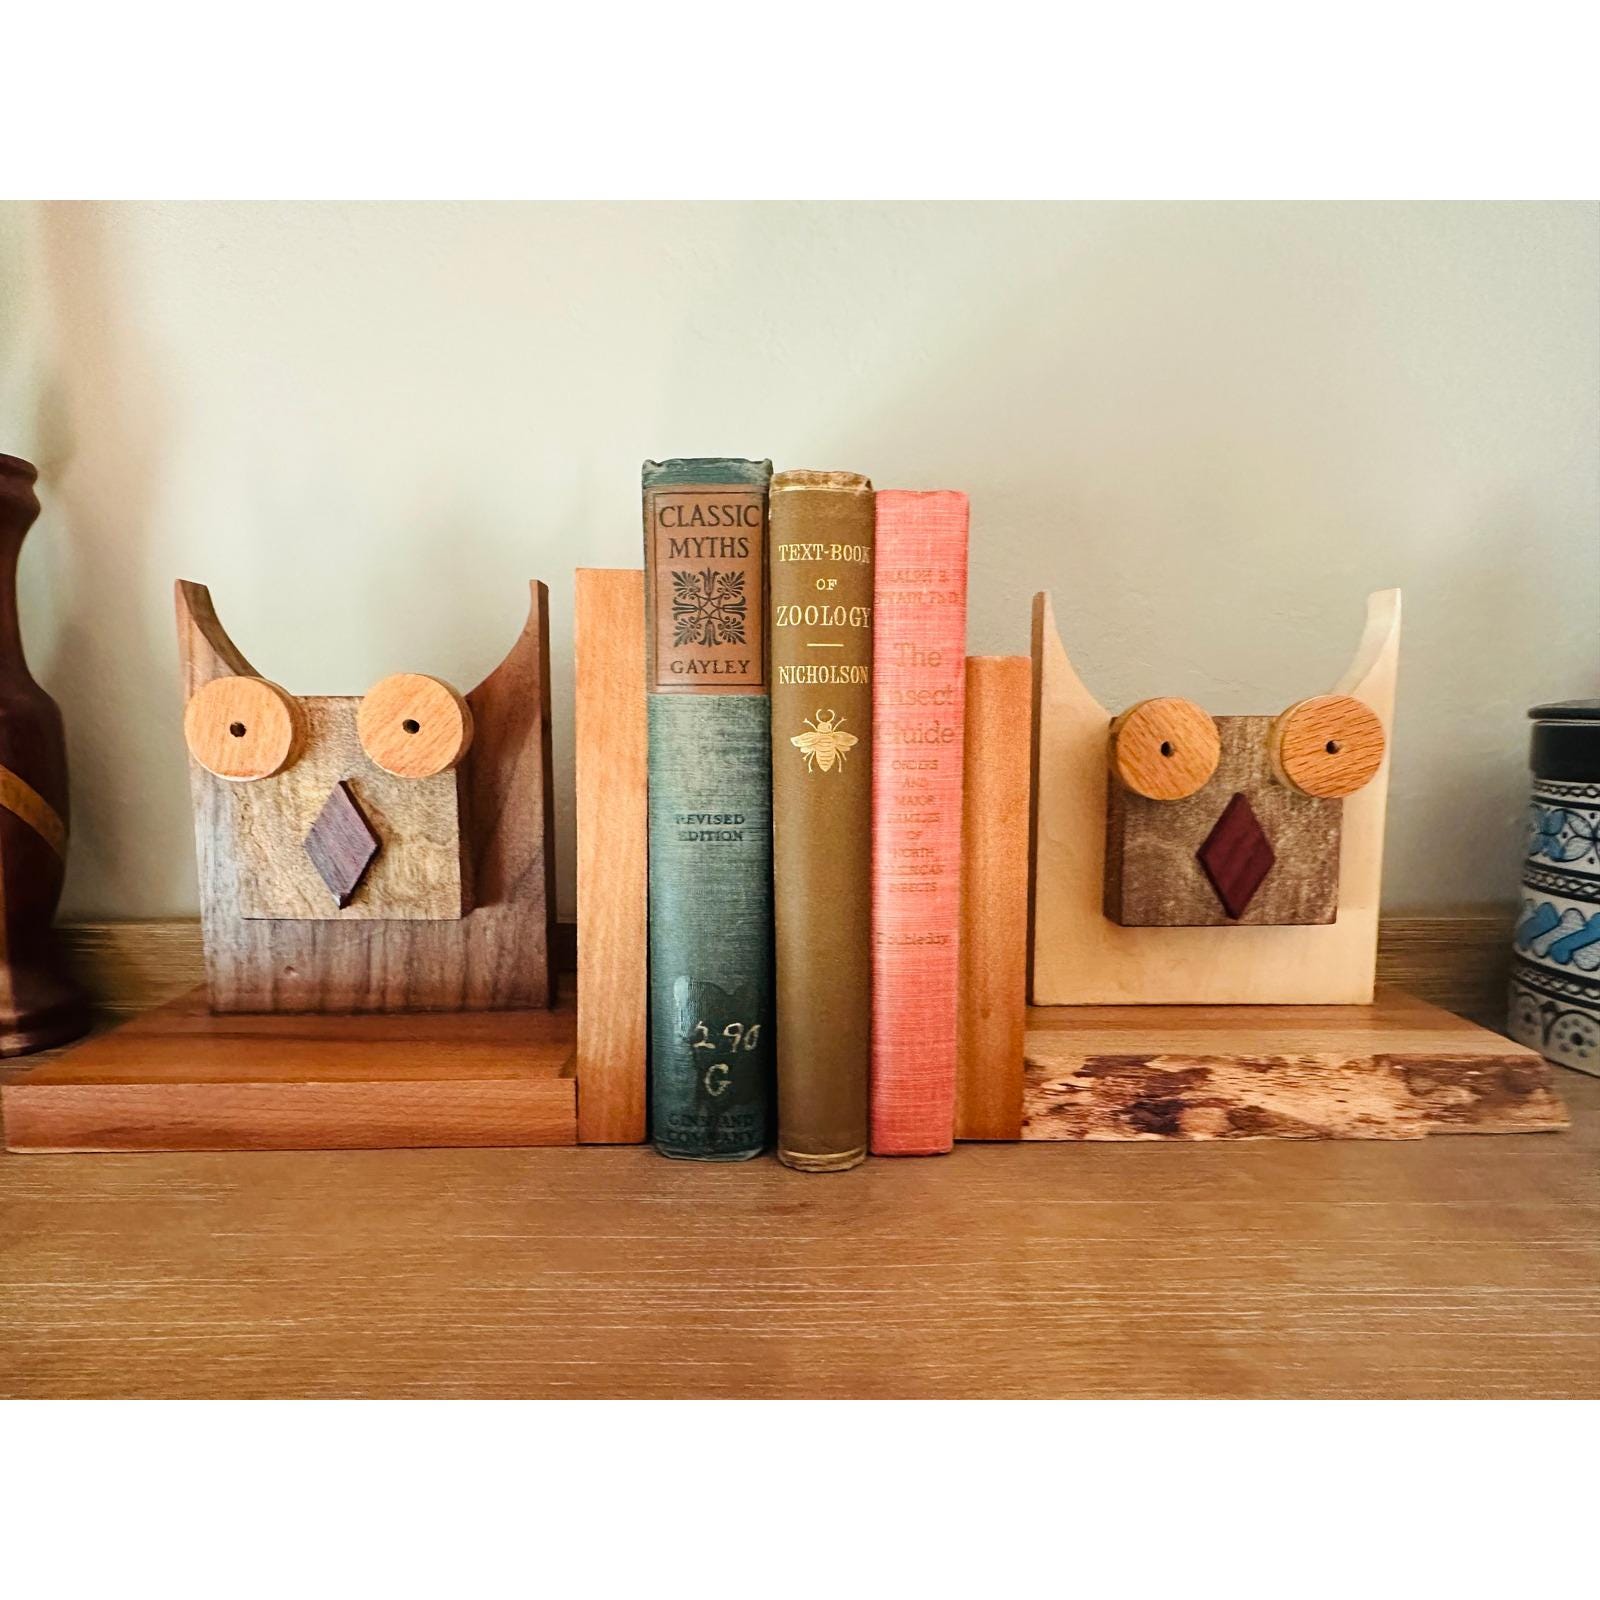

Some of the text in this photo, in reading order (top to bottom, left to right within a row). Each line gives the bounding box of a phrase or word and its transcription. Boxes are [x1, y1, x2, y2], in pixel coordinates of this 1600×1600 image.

[658, 504, 760, 528] CLASSIC
[668, 536, 750, 559] MYTHS
[778, 543, 872, 563] TEXT-BOOK
[815, 578, 838, 591] OF
[776, 605, 872, 628] ZOOLOGY
[893, 642, 942, 667] The
[670, 659, 751, 674] GAYLEY
[778, 665, 870, 685] NICHOLSON
[675, 813, 745, 825] REVISED
[678, 830, 743, 841] EDITION
[704, 1063, 732, 1096] G
